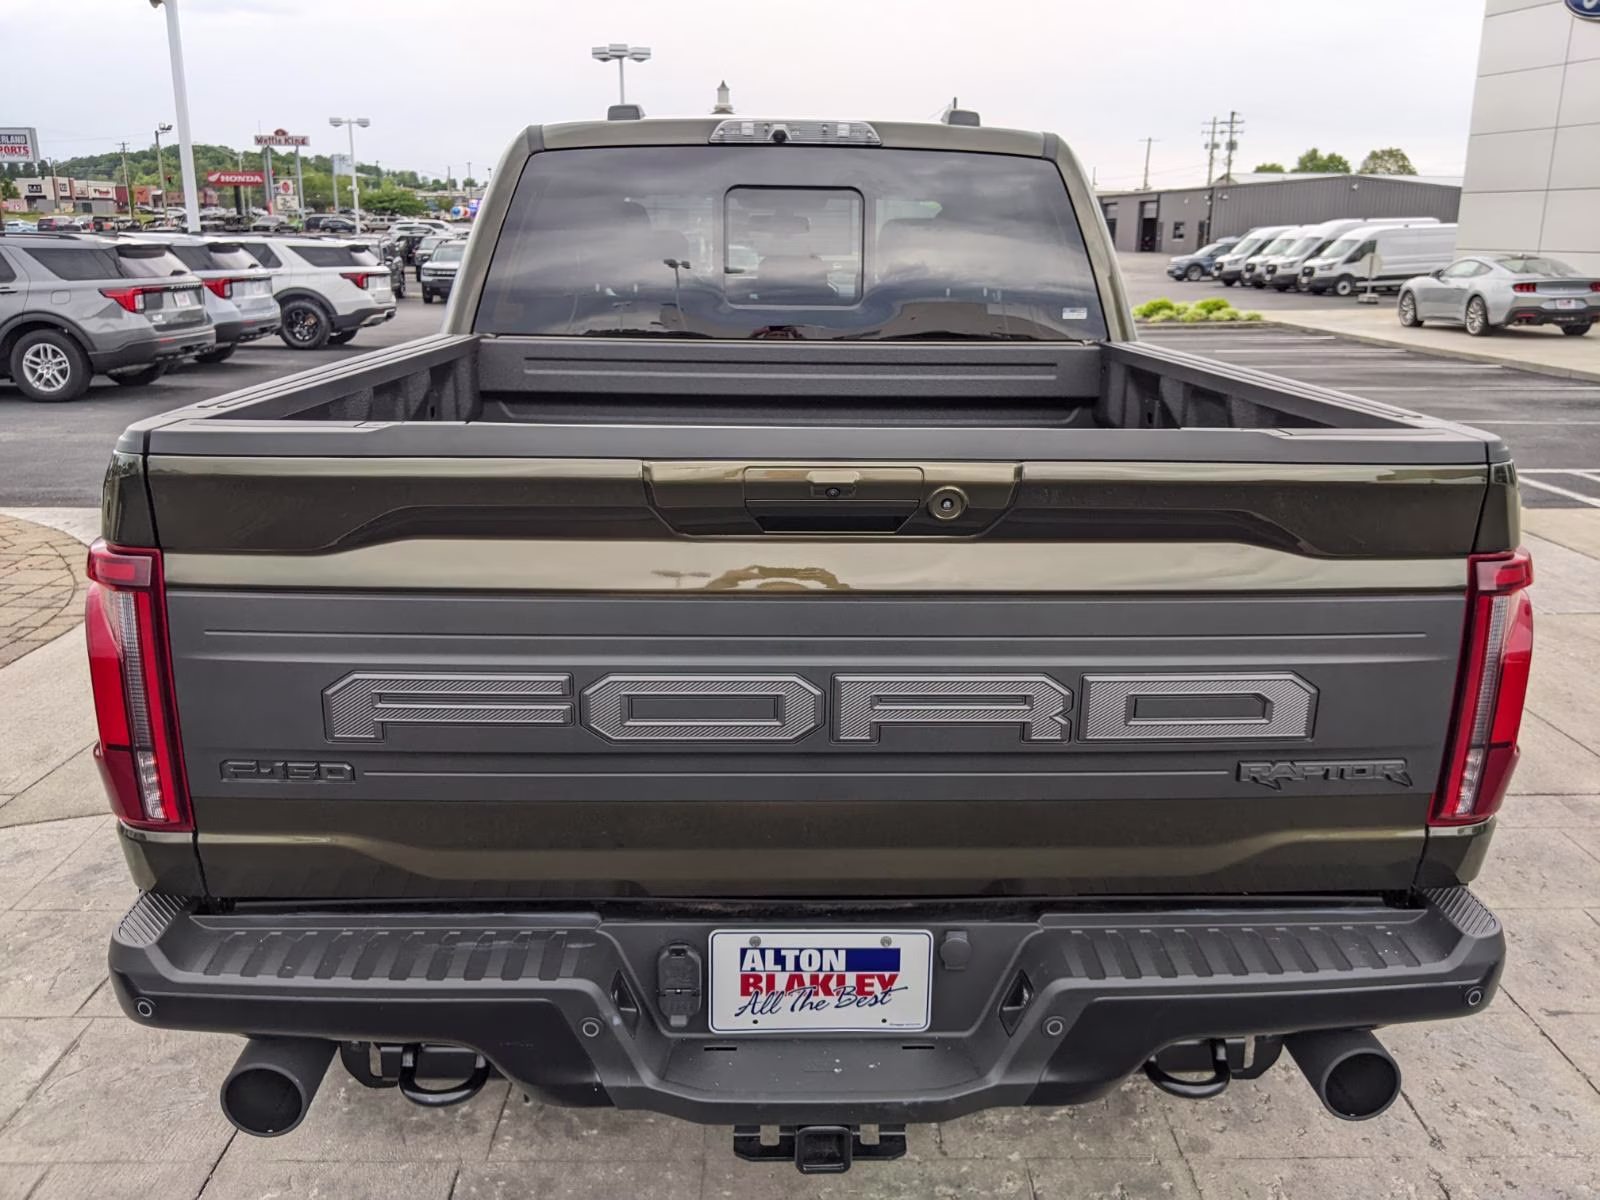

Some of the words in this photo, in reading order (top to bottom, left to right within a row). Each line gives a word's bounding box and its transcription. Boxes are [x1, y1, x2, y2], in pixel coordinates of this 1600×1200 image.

[0, 135, 26, 144] RLAND
[220, 174, 263, 183] HONDA
[321, 671, 1319, 744] FORD
[1235, 757, 1413, 792] RAPTOR
[741, 948, 847, 972] ALTON
[740, 973, 899, 997] BLAKLEY
[734, 989, 785, 1017] All
[787, 985, 831, 1013] The
[834, 985, 908, 1009] Best
